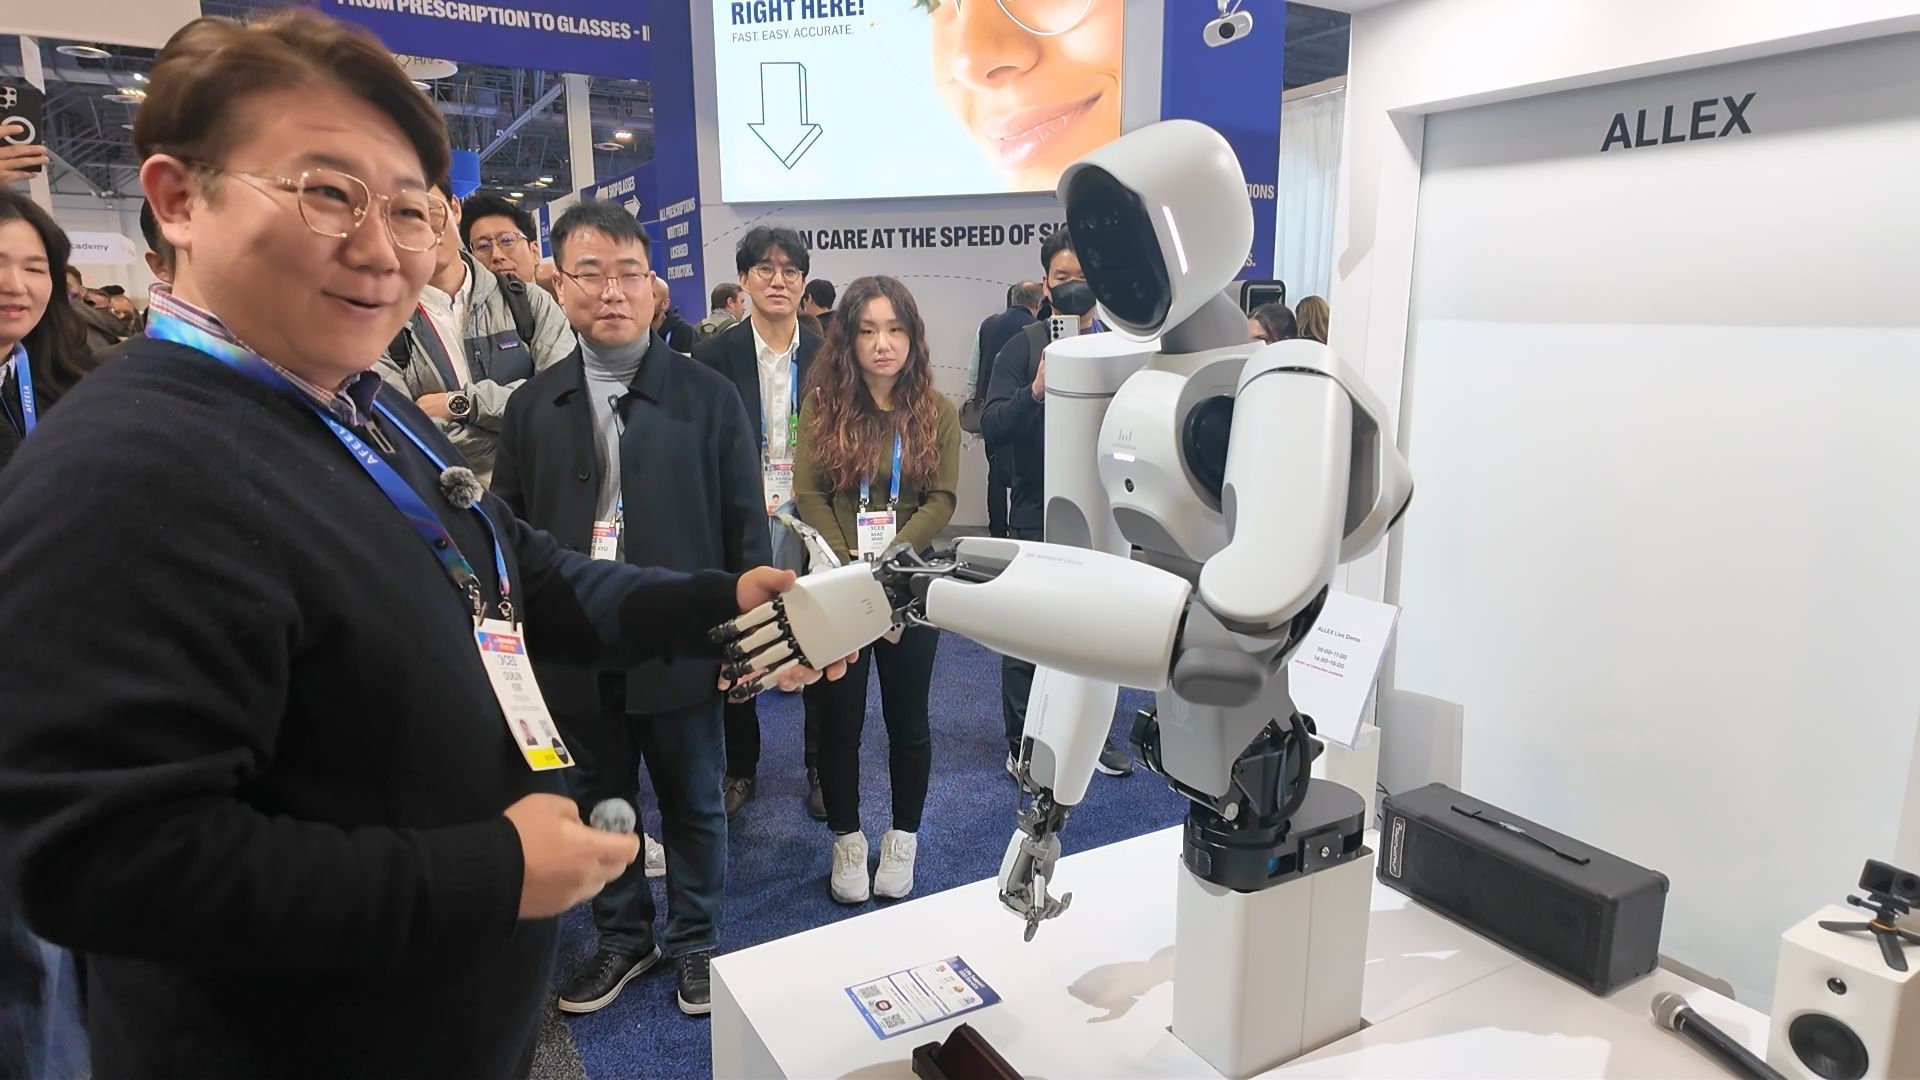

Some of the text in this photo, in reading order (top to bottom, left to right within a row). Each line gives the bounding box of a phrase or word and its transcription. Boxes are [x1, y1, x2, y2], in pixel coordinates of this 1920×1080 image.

[338, 0, 394, 11] OM
[397, 0, 530, 28] PRESCRIPTION
[531, 12, 555, 31] TO
[557, 15, 631, 40] GLASSES
[731, 0, 864, 25] RIGHT HERE!
[732, 24, 855, 42] FAST. EASY. ACCURATE.
[1600, 92, 1757, 152] ALLEX
[817, 229, 868, 250] CARE
[871, 228, 895, 249] AT
[899, 227, 937, 248] THE
[940, 225, 1005, 248] SPEED
[1009, 224, 1035, 245] OF
[1318, 626, 1335, 635] ALLEX
[1335, 631, 1345, 639] Live
